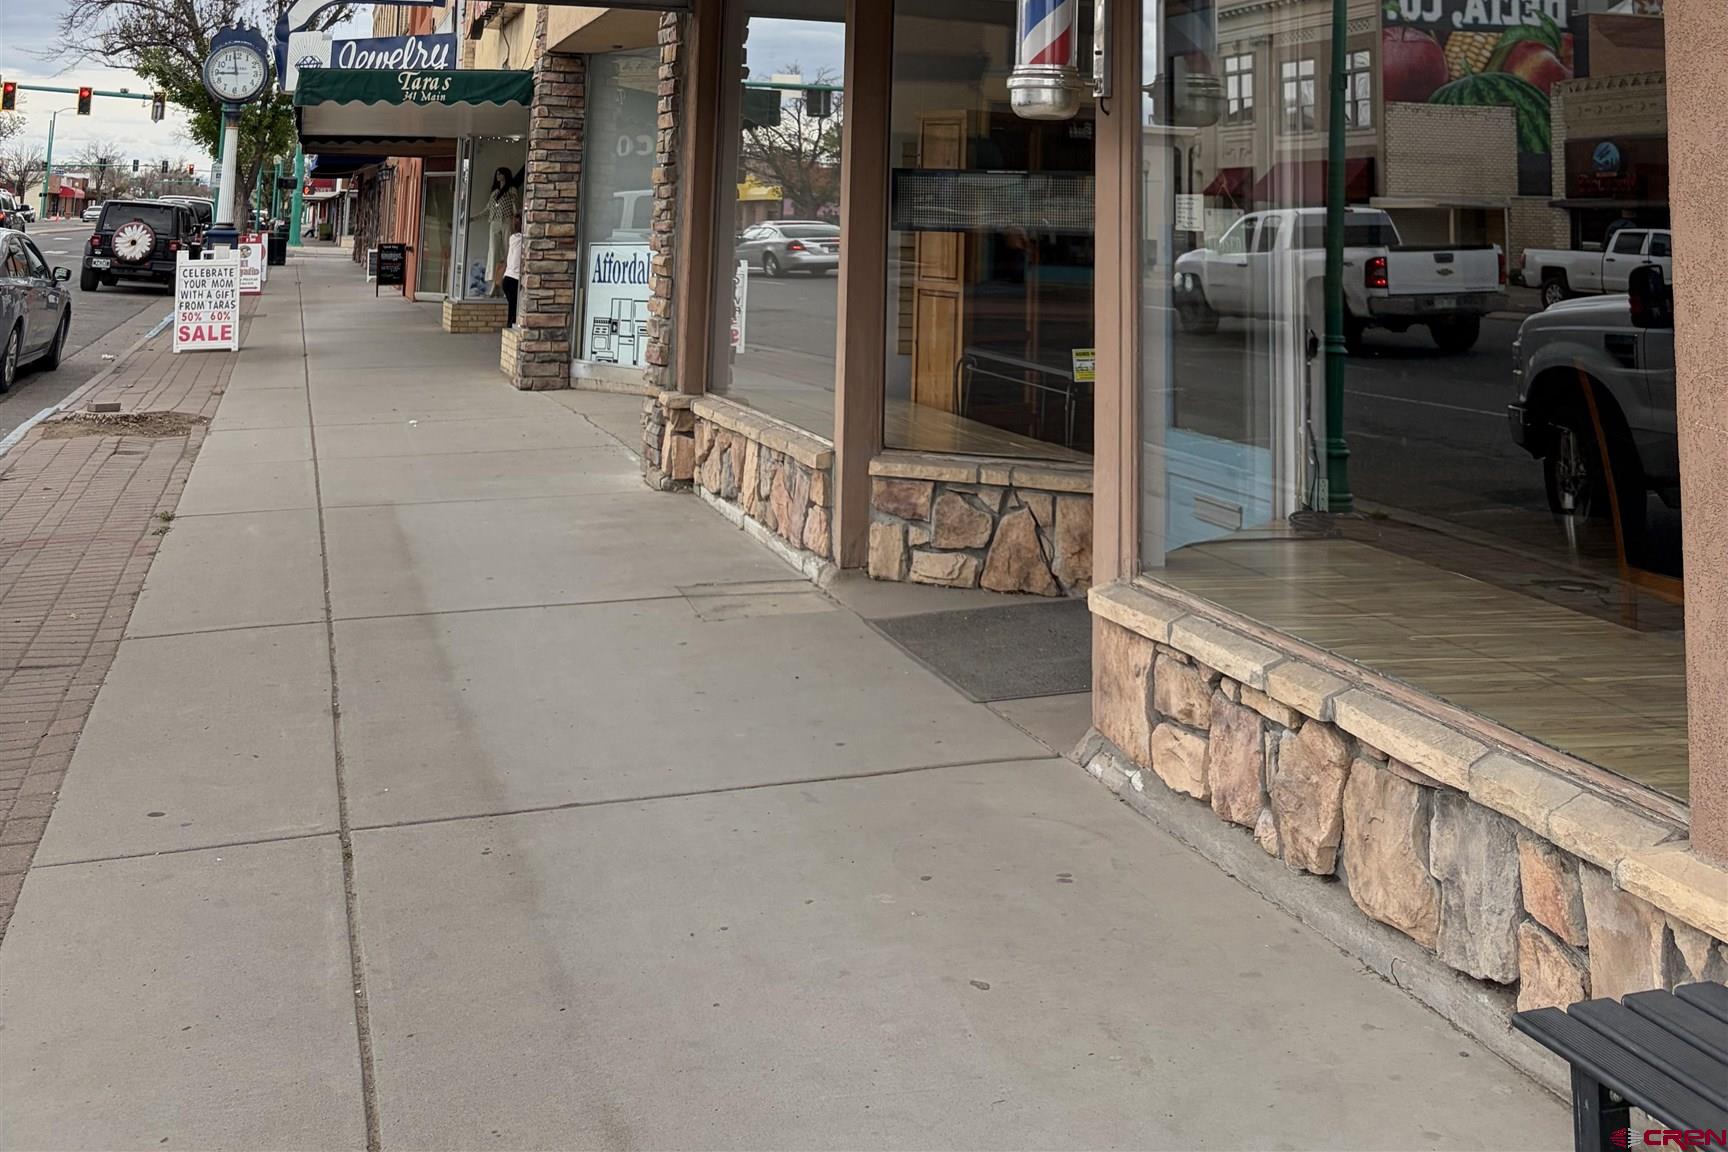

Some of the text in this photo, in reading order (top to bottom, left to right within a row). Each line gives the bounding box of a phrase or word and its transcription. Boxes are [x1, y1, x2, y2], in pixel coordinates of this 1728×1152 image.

[338, 36, 449, 70] Jewelry
[420, 91, 446, 101] Main
[182, 268, 234, 278] CELEBRATE
[184, 279, 207, 288] YOUR
[211, 279, 234, 288] MOM
[180, 289, 235, 299] WITH A GIFT
[179, 300, 236, 310] FROM TARAS
[181, 311, 231, 321] 50% 60%
[178, 324, 232, 342] SALE
